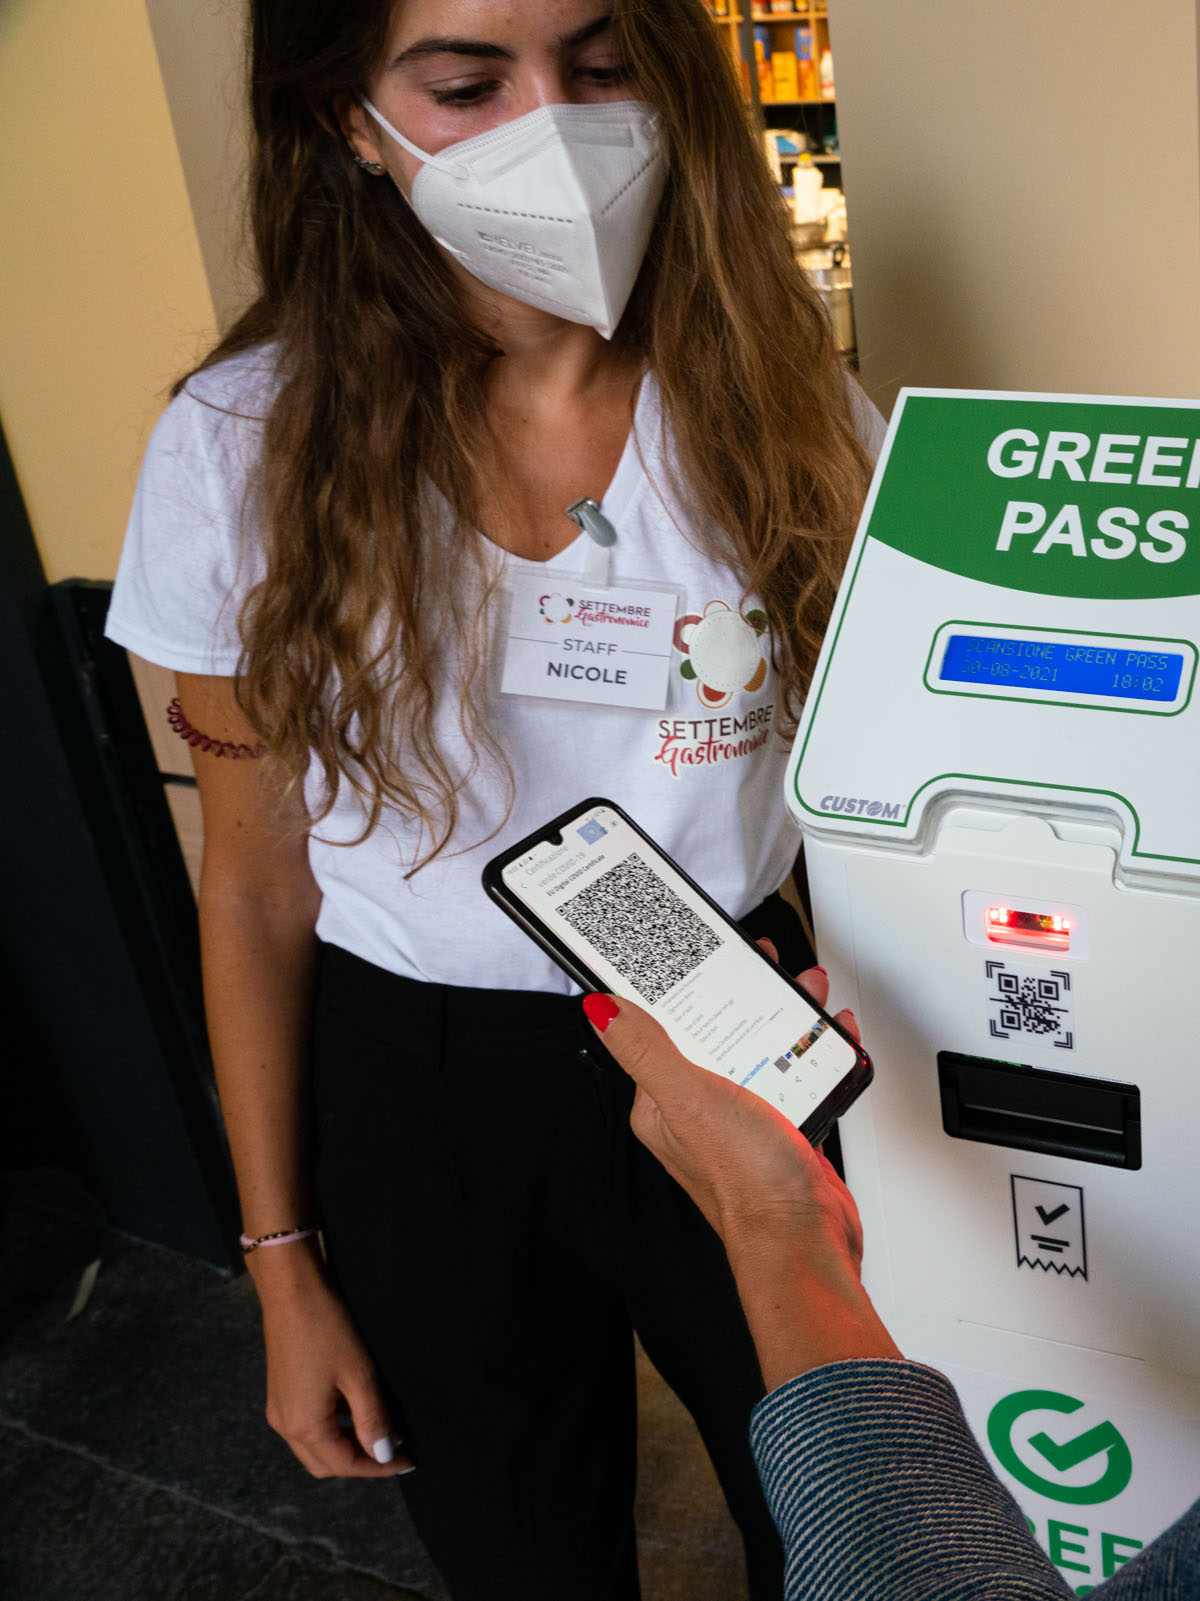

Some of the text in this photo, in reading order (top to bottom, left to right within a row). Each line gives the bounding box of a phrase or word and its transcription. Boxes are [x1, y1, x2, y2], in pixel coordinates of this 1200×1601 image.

[995, 500, 1189, 563] PASS
[578, 599, 652, 618] SETTEMBRE
[563, 638, 619, 656] STAFF
[965, 638, 1169, 671] SCANSIONE GREEN PASS
[547, 662, 628, 685] NICOLE
[960, 659, 1164, 693] 30-08-2021 18:02
[658, 704, 774, 740] SETTEMBRE
[820, 795, 901, 820] CUSTOM
